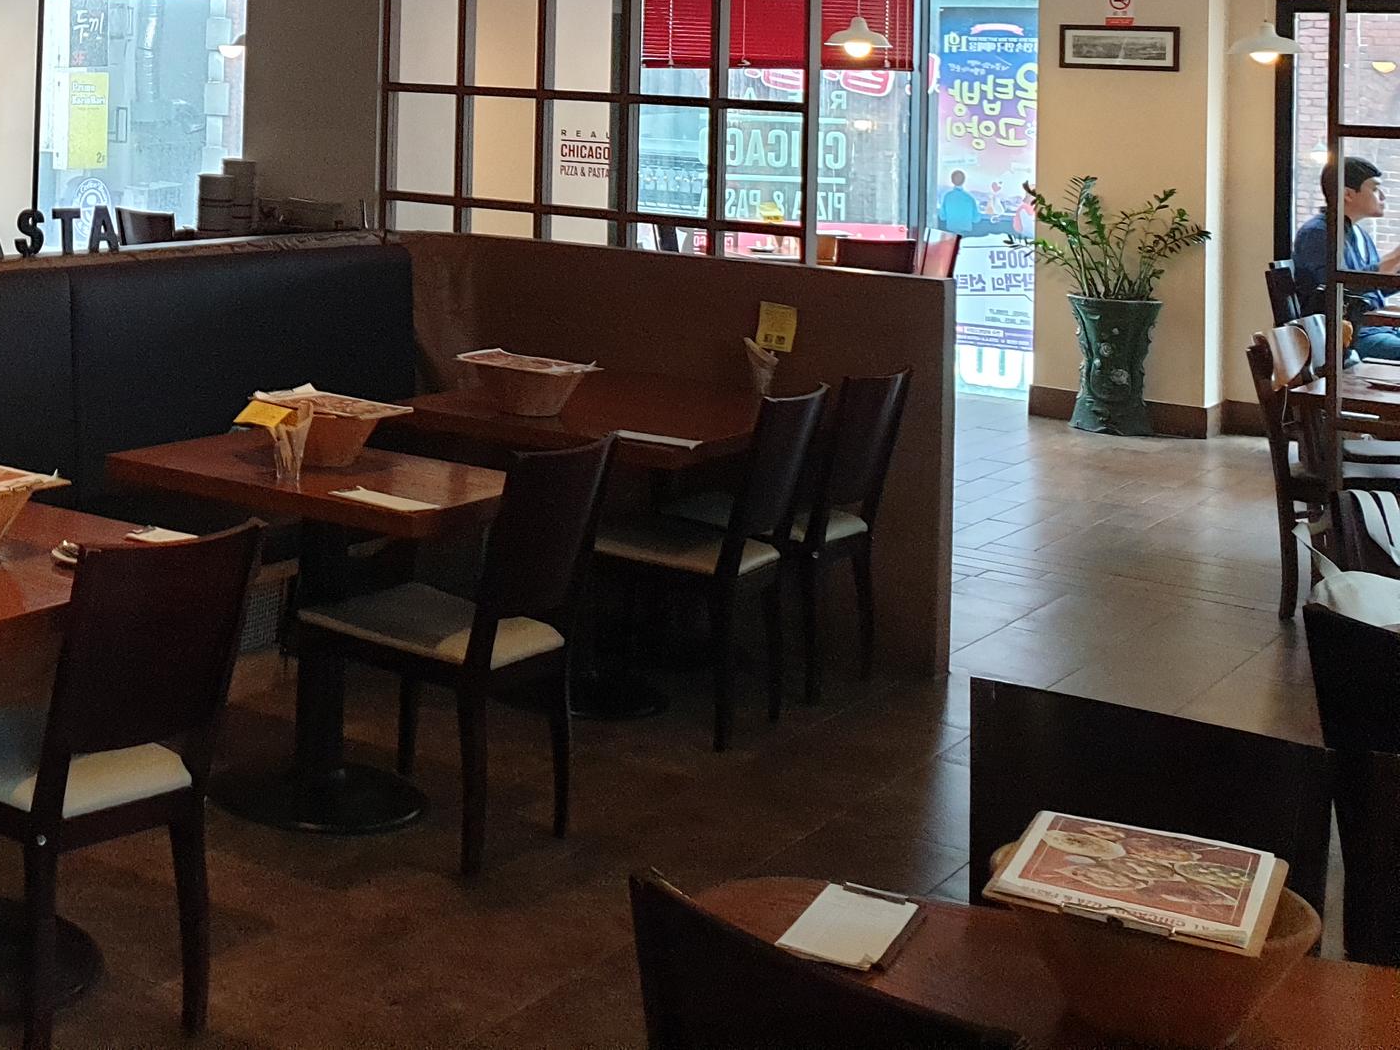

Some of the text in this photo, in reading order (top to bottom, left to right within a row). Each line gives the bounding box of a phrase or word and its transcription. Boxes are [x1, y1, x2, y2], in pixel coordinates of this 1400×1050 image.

[560, 143, 611, 161] CHICAGO
[560, 165, 578, 177] PIZZA
[580, 167, 586, 178] &
